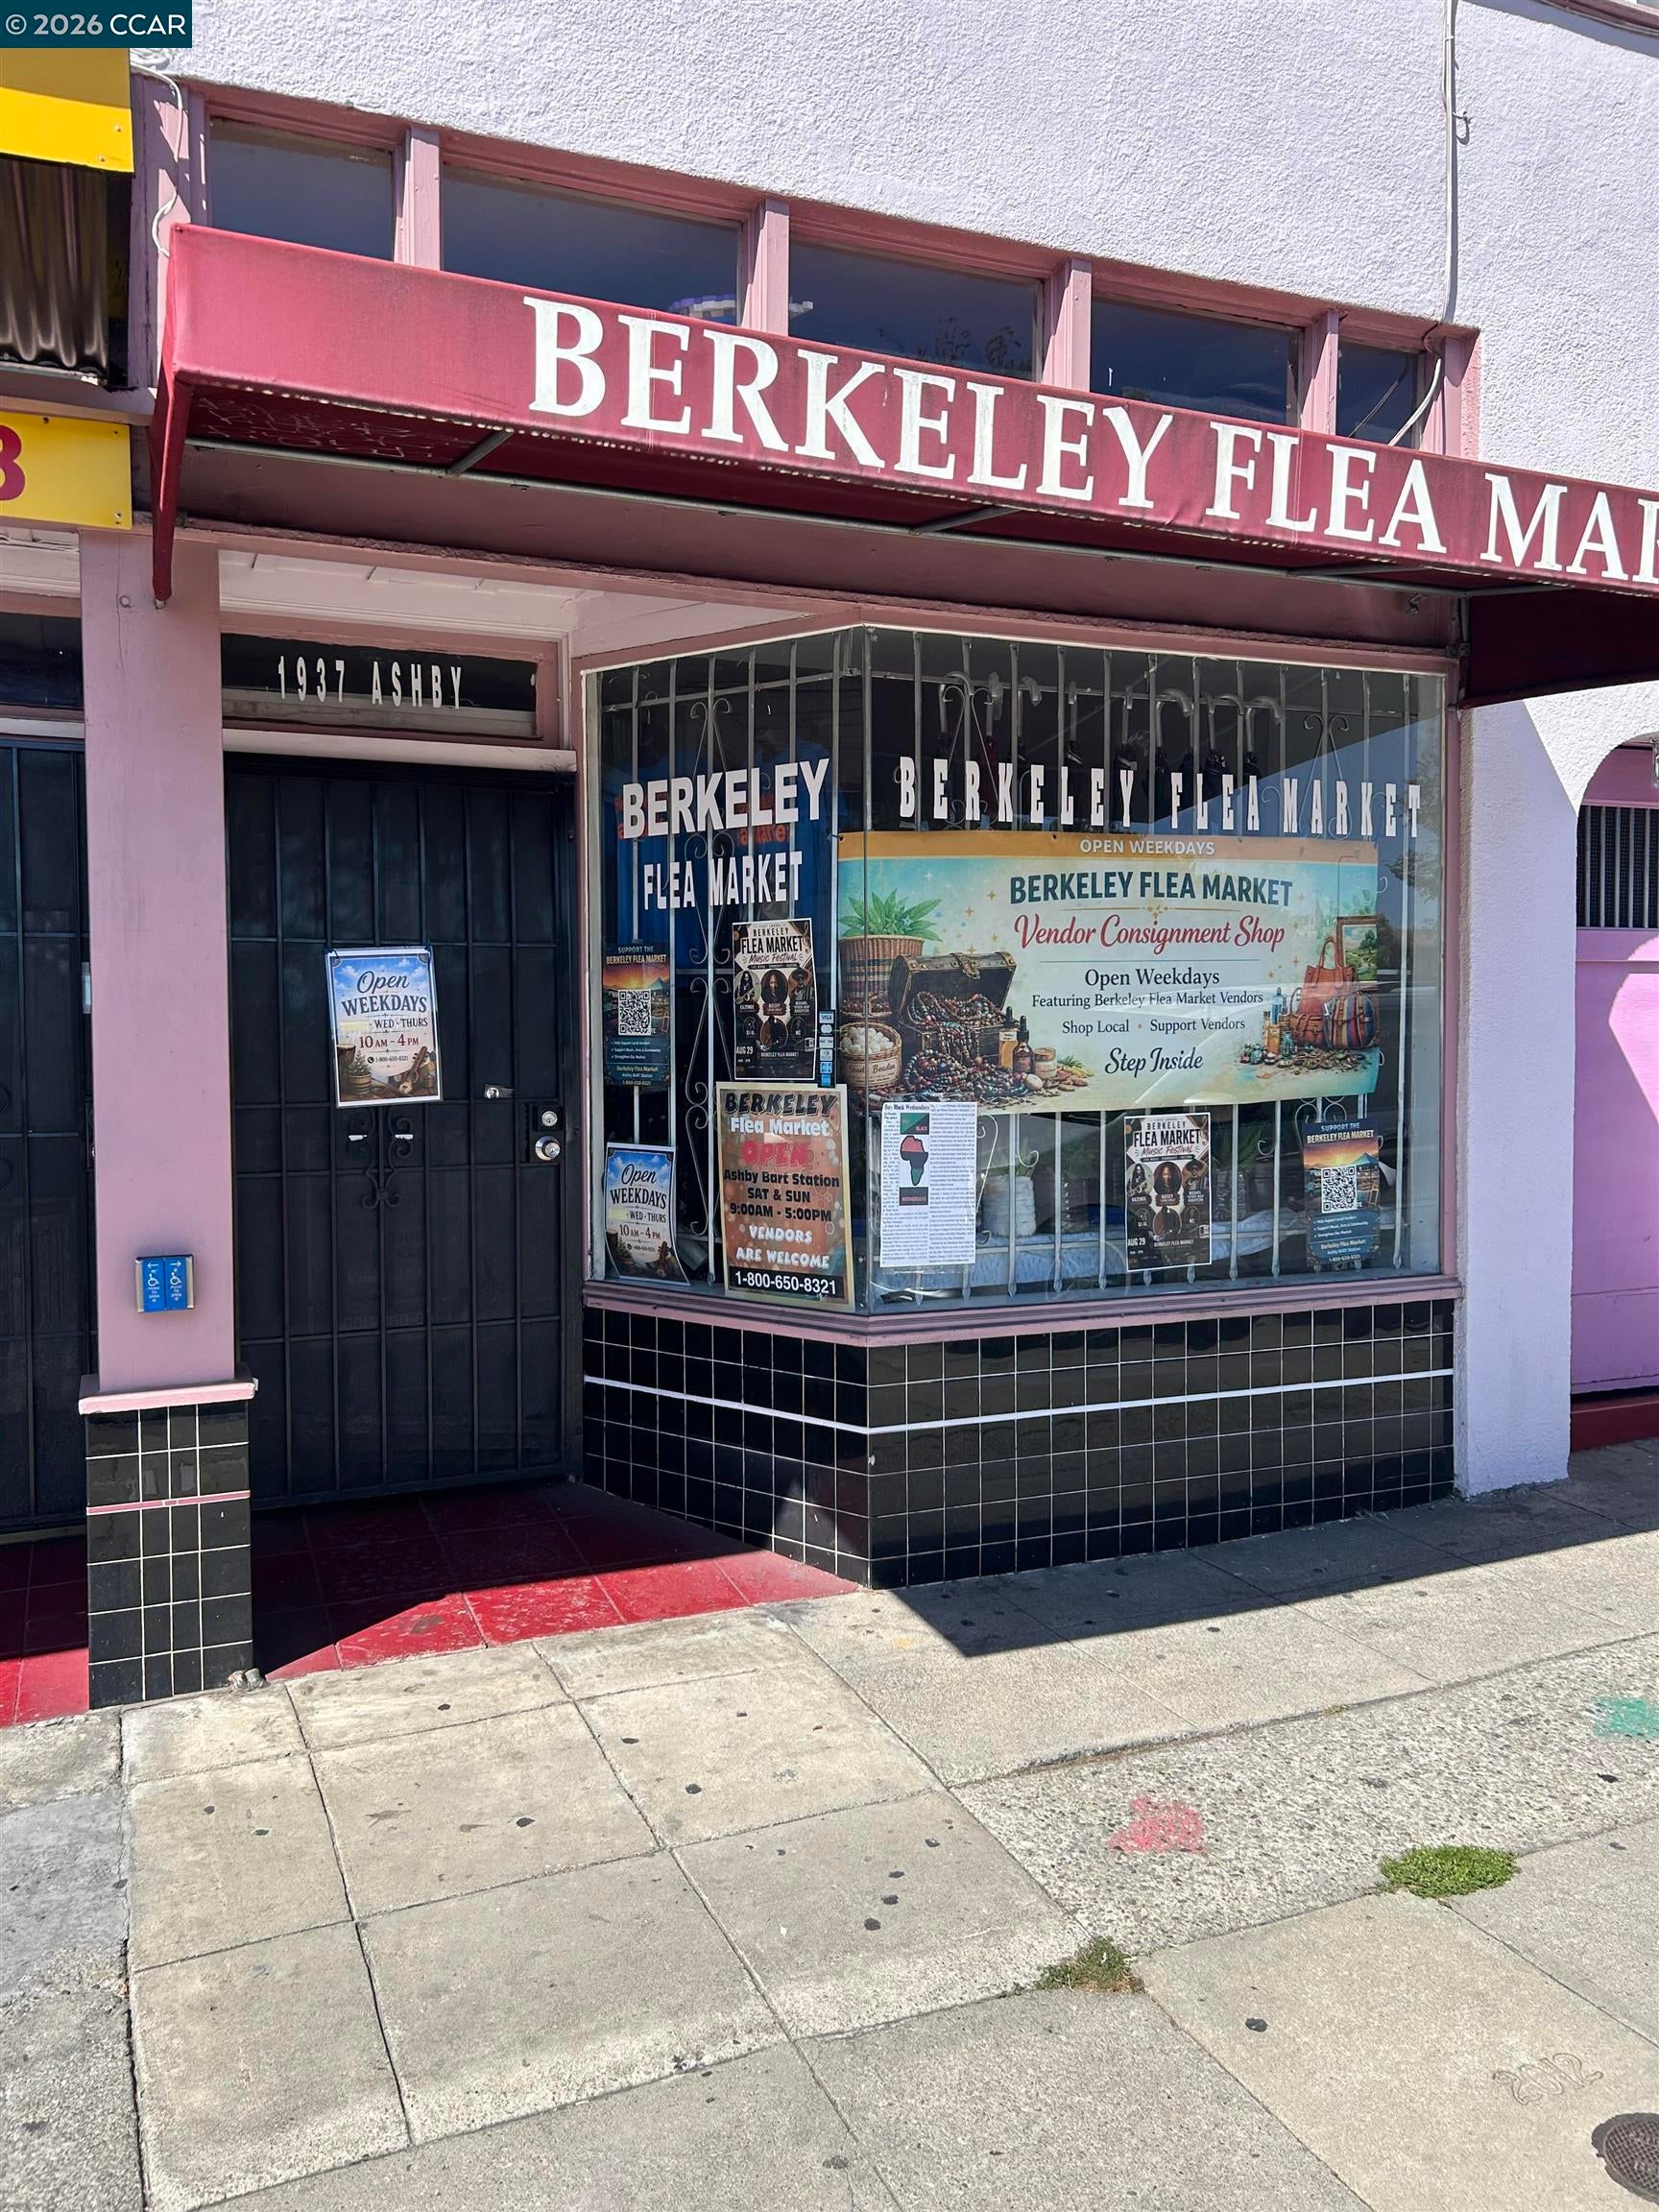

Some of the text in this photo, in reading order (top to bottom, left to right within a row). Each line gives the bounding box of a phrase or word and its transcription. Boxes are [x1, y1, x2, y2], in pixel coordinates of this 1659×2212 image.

[524, 297, 1173, 509] BERKELEY
[1206, 421, 1447, 554] FLEA
[277, 655, 462, 710] 1937 ASHBY
[623, 757, 830, 839] BERKELEY
[899, 756, 1421, 838] BERKELEY FLEA MARKET
[1079, 838, 1215, 856] OPEN WEEKDAYS
[643, 851, 803, 911] FLEA MARKET
[1009, 870, 1293, 907] BERKELEY FLEA MARKET
[753, 927, 789, 937] BERKELEY
[1013, 913, 1286, 955] Vendor Consignment Shop
[741, 936, 804, 954] FLEA MARKET
[606, 953, 667, 965] BERKELEY FLEA MARKET
[356, 971, 410, 994] Open
[1085, 967, 1220, 991] Open Weekdays
[341, 995, 427, 1017] WEEKDAYS
[1031, 991, 1263, 1010] Featuring Berkeley Flea Market Vendors
[373, 1018, 428, 1029] WED THURS
[1062, 1018, 1245, 1037] Shop Local Support Vendors
[359, 1035, 373, 1048] 10
[374, 1039, 388, 1047] AM
[397, 1034, 405, 1046] 4
[407, 1037, 420, 1046] PM
[736, 1046, 754, 1055] AUG 29
[1104, 1046, 1205, 1078] Step Inside
[724, 1092, 837, 1117] BERKELEY
[730, 1117, 830, 1137] Flea Market
[1146, 1120, 1187, 1131] BERKELEY
[1320, 1121, 1360, 1132] SUPPORT THE
[1134, 1128, 1201, 1147] FLEA MARKET
[1307, 1130, 1375, 1143] BERKELEY FLEA MARKET
[741, 1140, 808, 1167] OPEN
[621, 1164, 658, 1186] Open
[724, 1168, 840, 1189] Ashby Bart Station
[610, 1187, 667, 1210] WEEKDAYS
[747, 1187, 811, 1204] SAT & SUN
[629, 1210, 667, 1223] WED THURS
[730, 1203, 774, 1218] 9:00AM
[784, 1207, 832, 1222] 5:00PM
[619, 1224, 630, 1237] 10
[645, 1227, 652, 1239] 4
[652, 1232, 661, 1240] PM
[748, 1224, 813, 1245] VENDORS
[1127, 1237, 1146, 1247] AUG 29
[735, 1247, 830, 1269] ARE WELCOME
[734, 1270, 836, 1295] 1-800-650-8321
